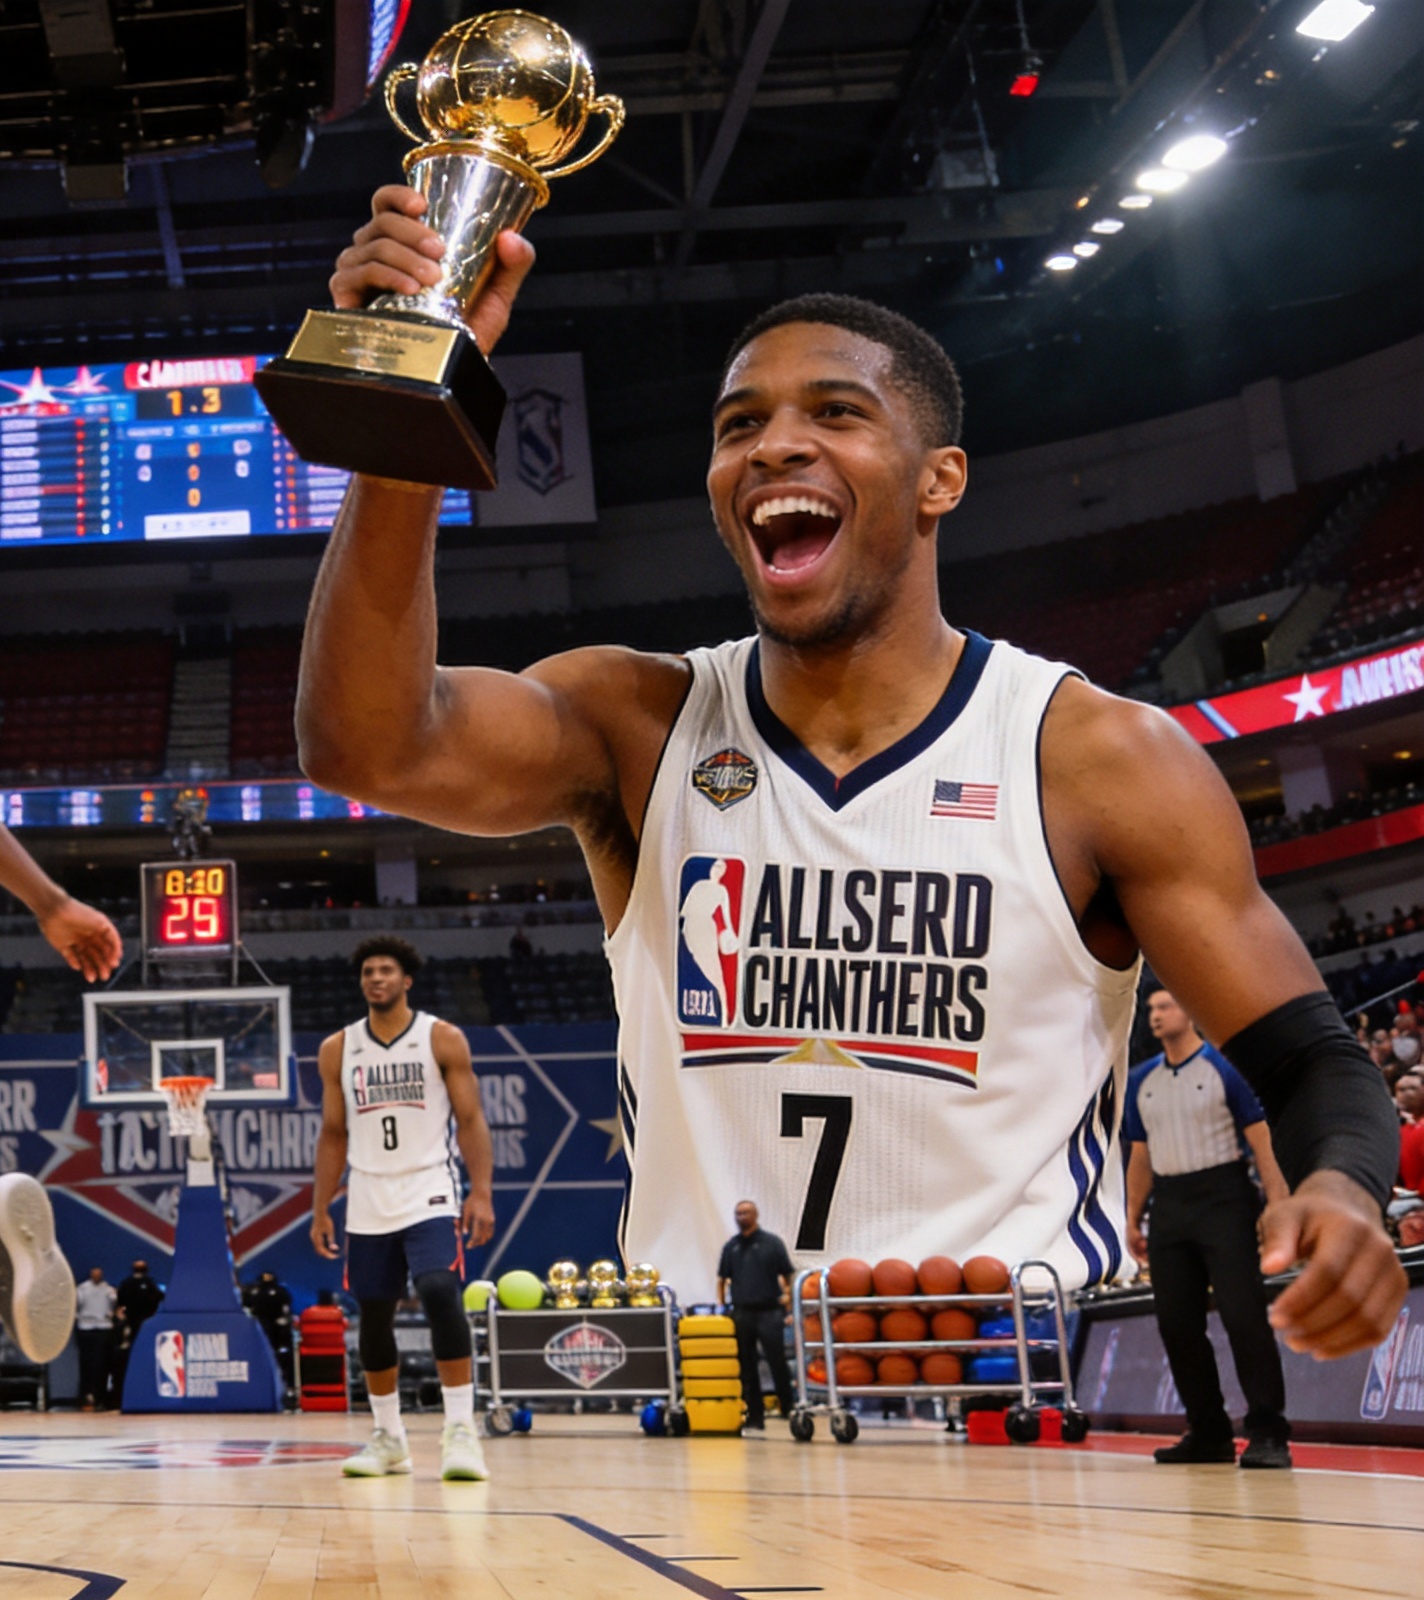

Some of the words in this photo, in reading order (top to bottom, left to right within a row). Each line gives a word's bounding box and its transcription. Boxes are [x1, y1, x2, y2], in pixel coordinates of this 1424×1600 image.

[749, 863, 994, 960] ALLSERD
[743, 954, 989, 1043] CHANTHERS
[779, 1092, 853, 1251] 7
